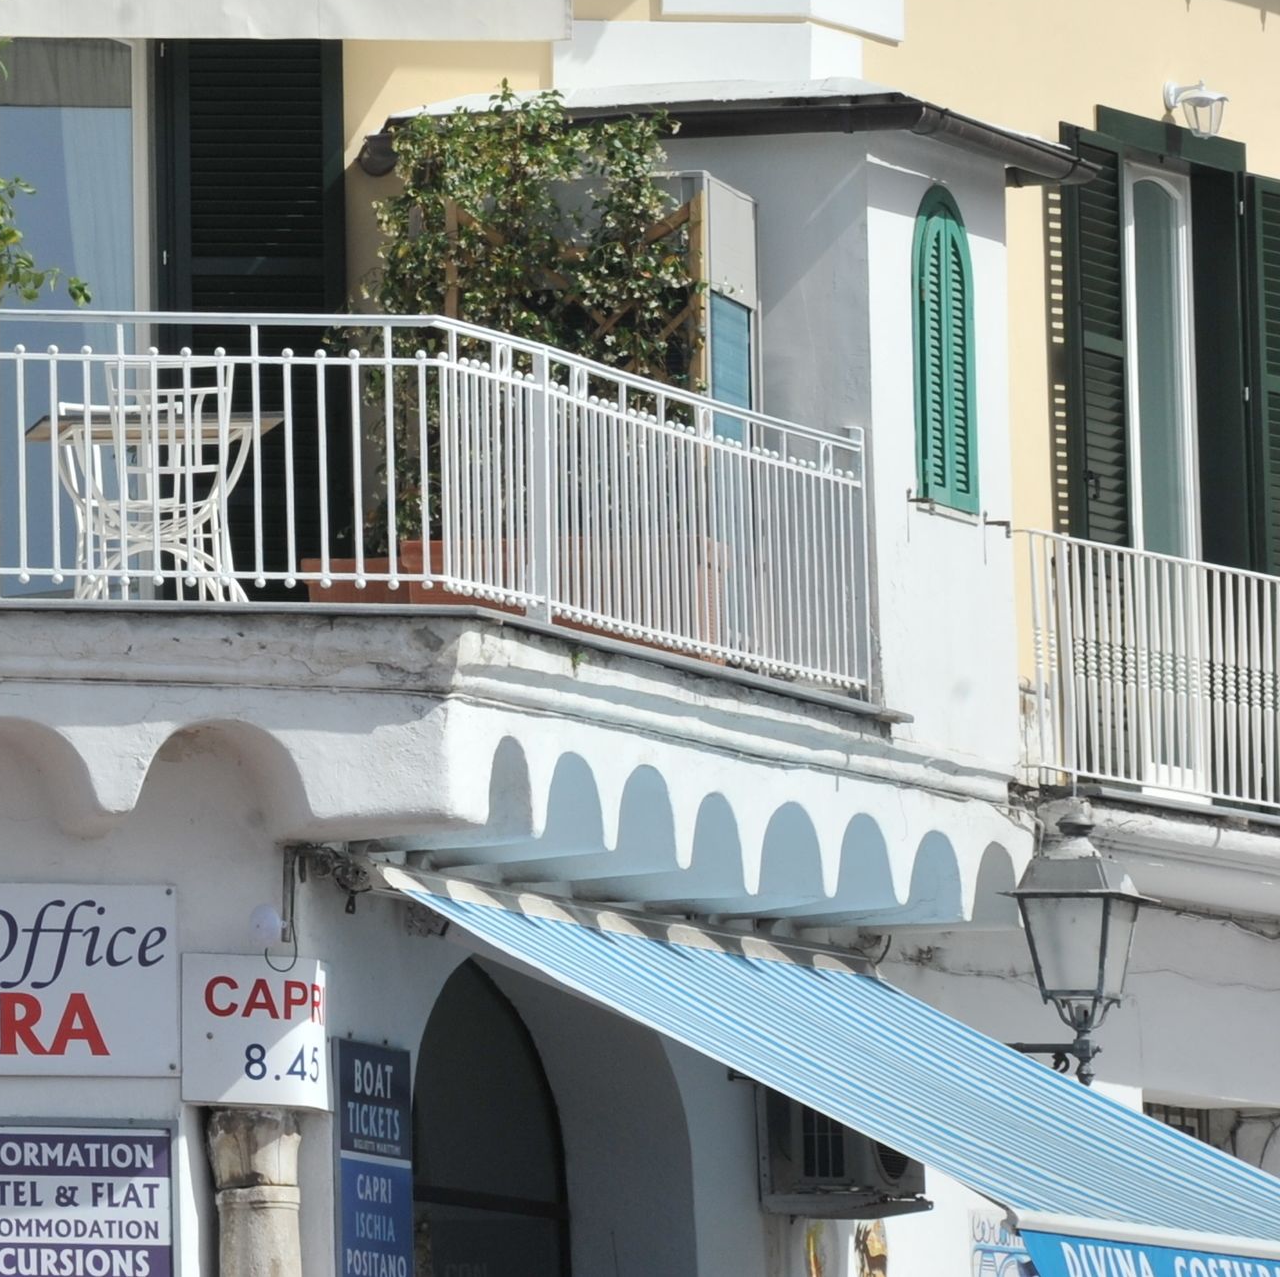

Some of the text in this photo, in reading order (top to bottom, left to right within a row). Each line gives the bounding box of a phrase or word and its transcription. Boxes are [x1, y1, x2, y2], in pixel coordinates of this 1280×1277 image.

[244, 1043, 320, 1083] 8.45
[354, 1058, 394, 1099] BOAT
[348, 1102, 400, 1141] TICKETS
[54, 1185, 80, 1208] &
[90, 1182, 160, 1209] FLAT
[356, 1174, 393, 1204] CAPRI
[355, 1211, 396, 1243] ISCHIA
[346, 1248, 407, 1277] POSITANO
